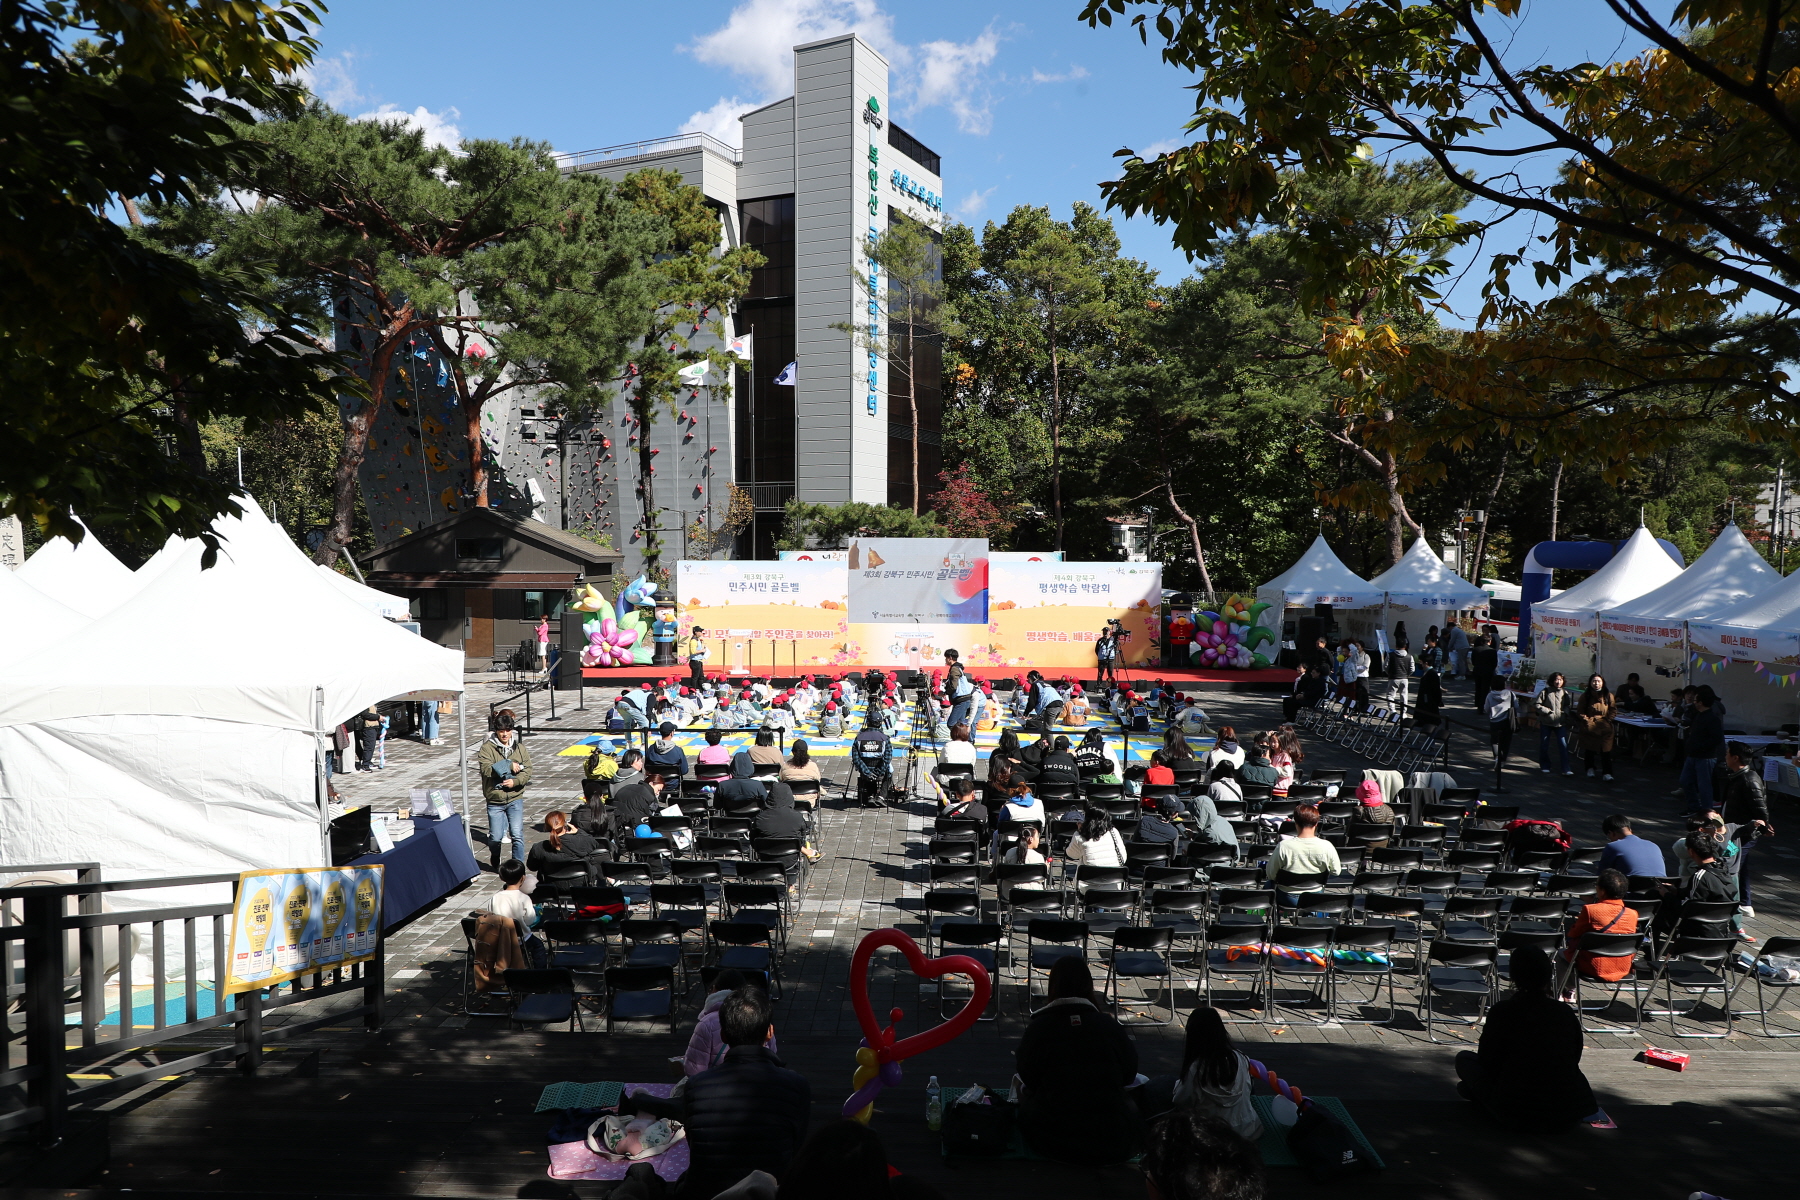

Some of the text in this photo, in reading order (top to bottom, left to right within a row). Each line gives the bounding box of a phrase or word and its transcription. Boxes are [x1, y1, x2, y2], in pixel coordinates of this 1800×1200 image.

[868, 144, 879, 216] 북한산
[743, 573, 785, 581] 제3회 강북구
[863, 568, 974, 581] 제3회 강북구 민주시민 골든벨
[1054, 574, 1096, 582] 제4회 강북구
[729, 581, 800, 593] 민주시민 골든벨
[1039, 582, 1110, 594] 평생학습 박람회
[764, 629, 803, 639] 주인공을
[806, 630, 834, 639] 찾아라!
[1026, 631, 1071, 642] 평생학습,
[1721, 634, 1758, 649] 페이스 페인팅
[1043, 763, 1072, 771] SWOOSH
